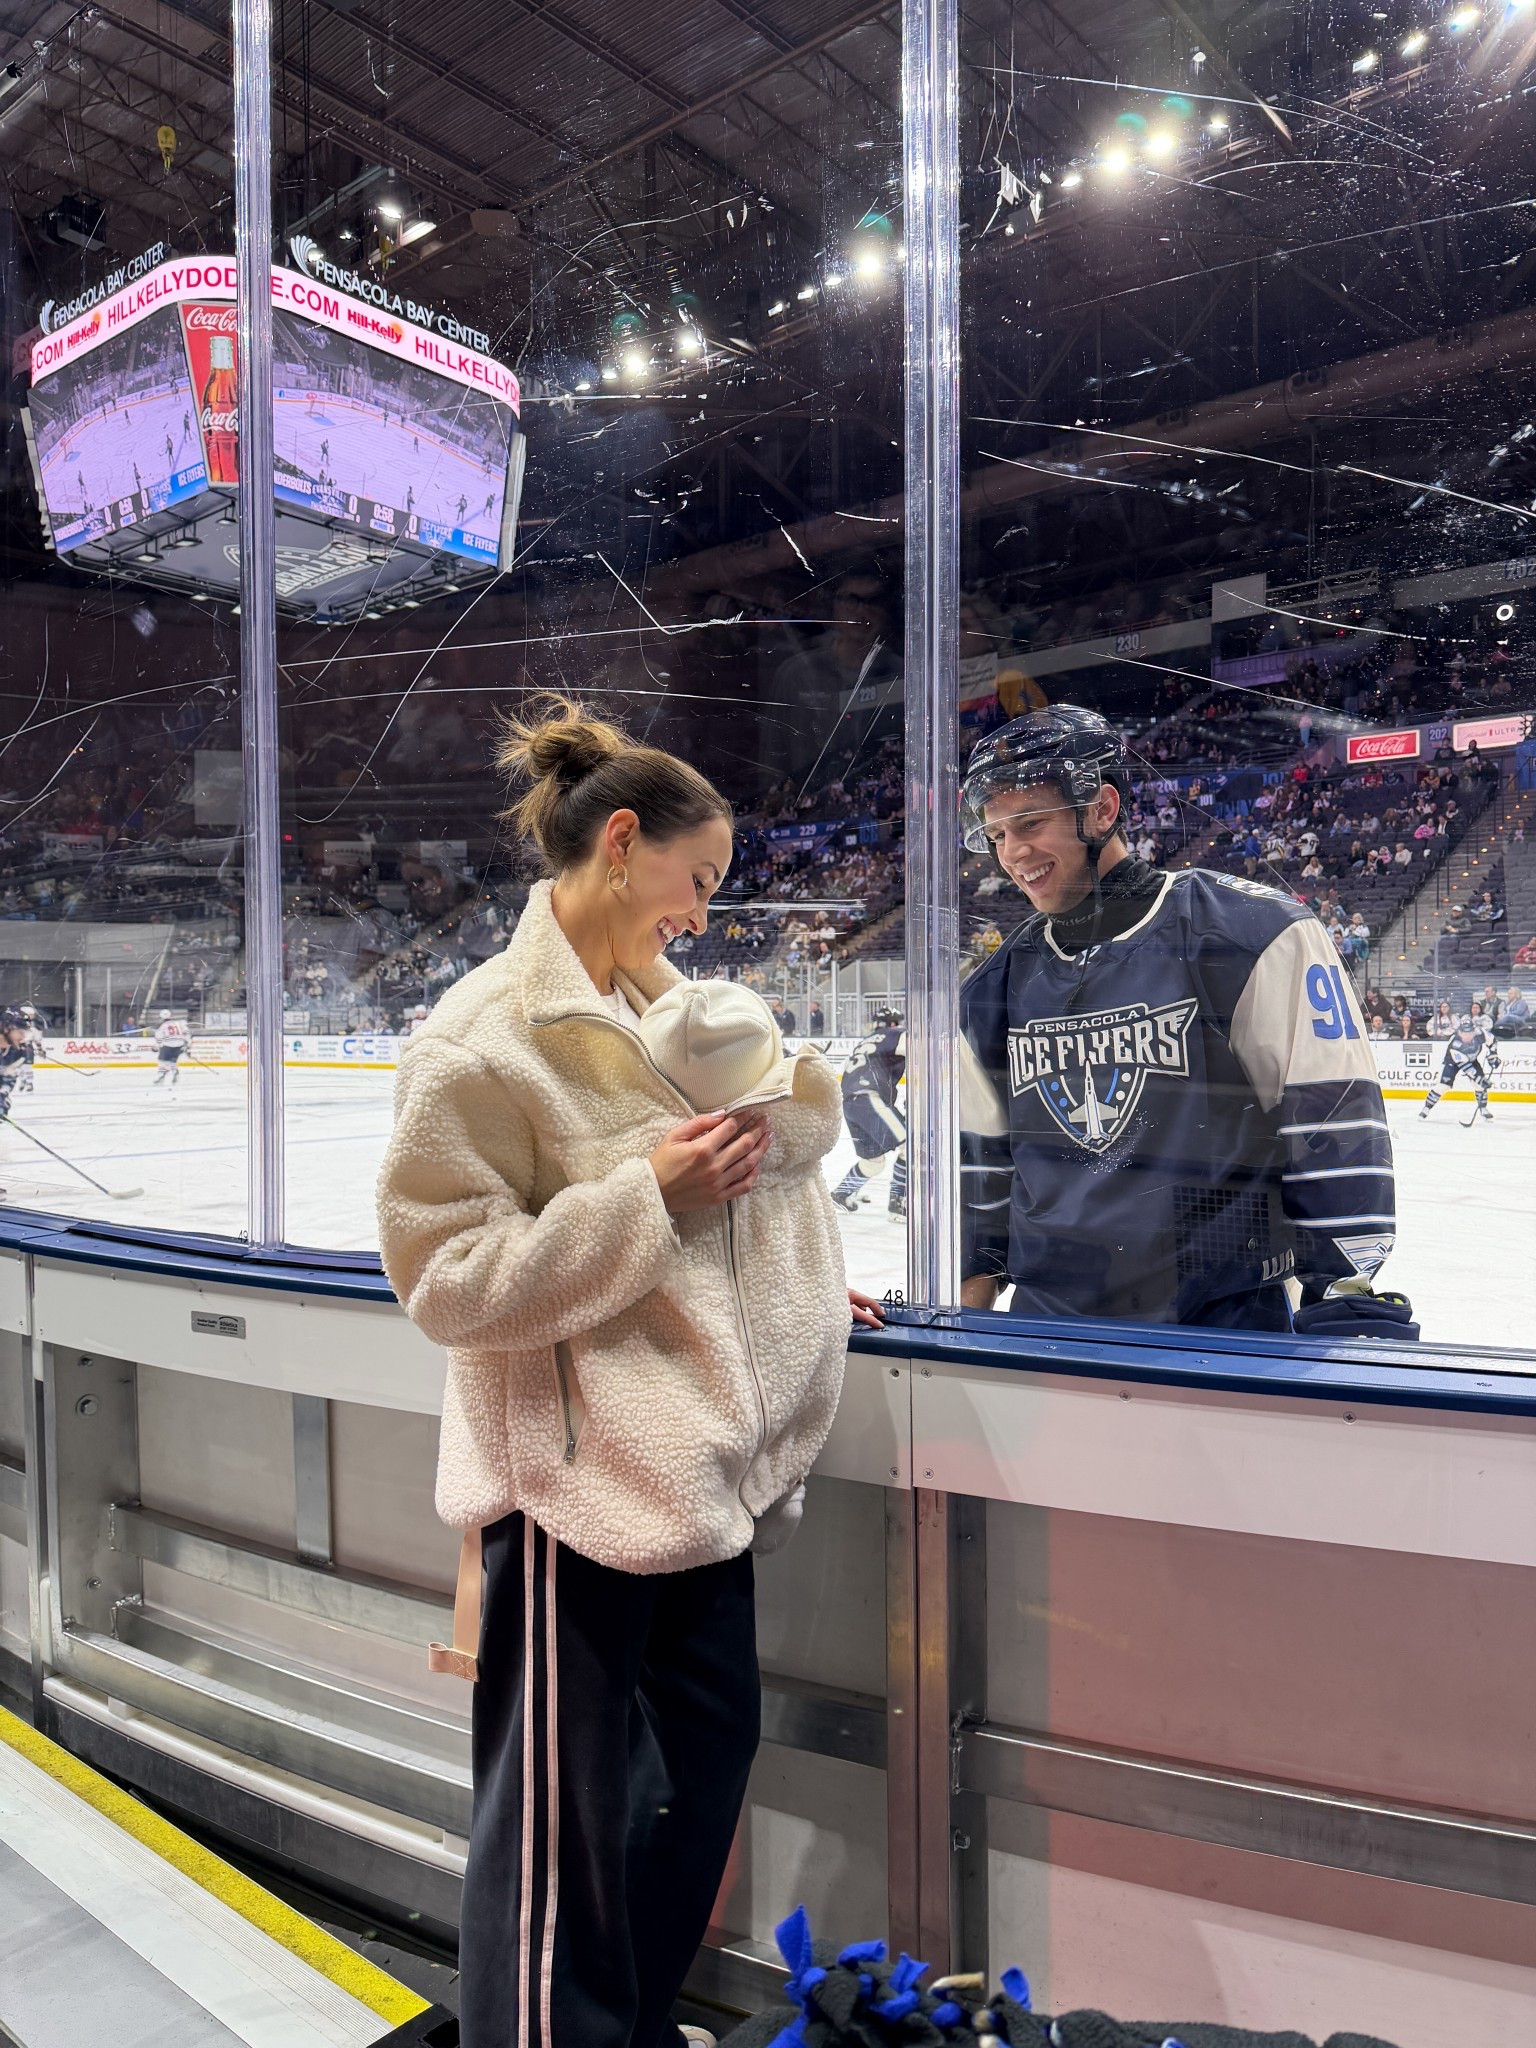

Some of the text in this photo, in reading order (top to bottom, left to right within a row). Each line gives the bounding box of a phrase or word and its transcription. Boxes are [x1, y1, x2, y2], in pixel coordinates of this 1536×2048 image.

[53, 241, 165, 329] PENSACOLA BAY CENTER
[316, 259, 490, 353] PENSACOLA BAY CENTER
[186, 306, 238, 332] Coca-Co
[32, 338, 64, 376] .COM
[347, 308, 520, 402] Hill-Kelly HILLKELLYD
[201, 407, 239, 432] Coca-C
[349, 494, 358, 515] 0
[408, 514, 418, 534] 0
[462, 532, 499, 554] ICE FLYERS
[1116, 633, 1140, 652] 230
[1429, 727, 1448, 741] 202
[1356, 736, 1407, 758] Coca-Cola
[1200, 794, 1213, 807] 101
[799, 824, 817, 836] 229
[1306, 963, 1361, 1040] 91
[1034, 1009, 1141, 1034] PENSACOLA
[1008, 1007, 1190, 1087] ICE FLYERS
[1377, 1070, 1439, 1081] GULF COA
[1492, 1081, 1536, 1091] LOSET
[238, 1230, 249, 1244] 49
[884, 1289, 904, 1307] 48
